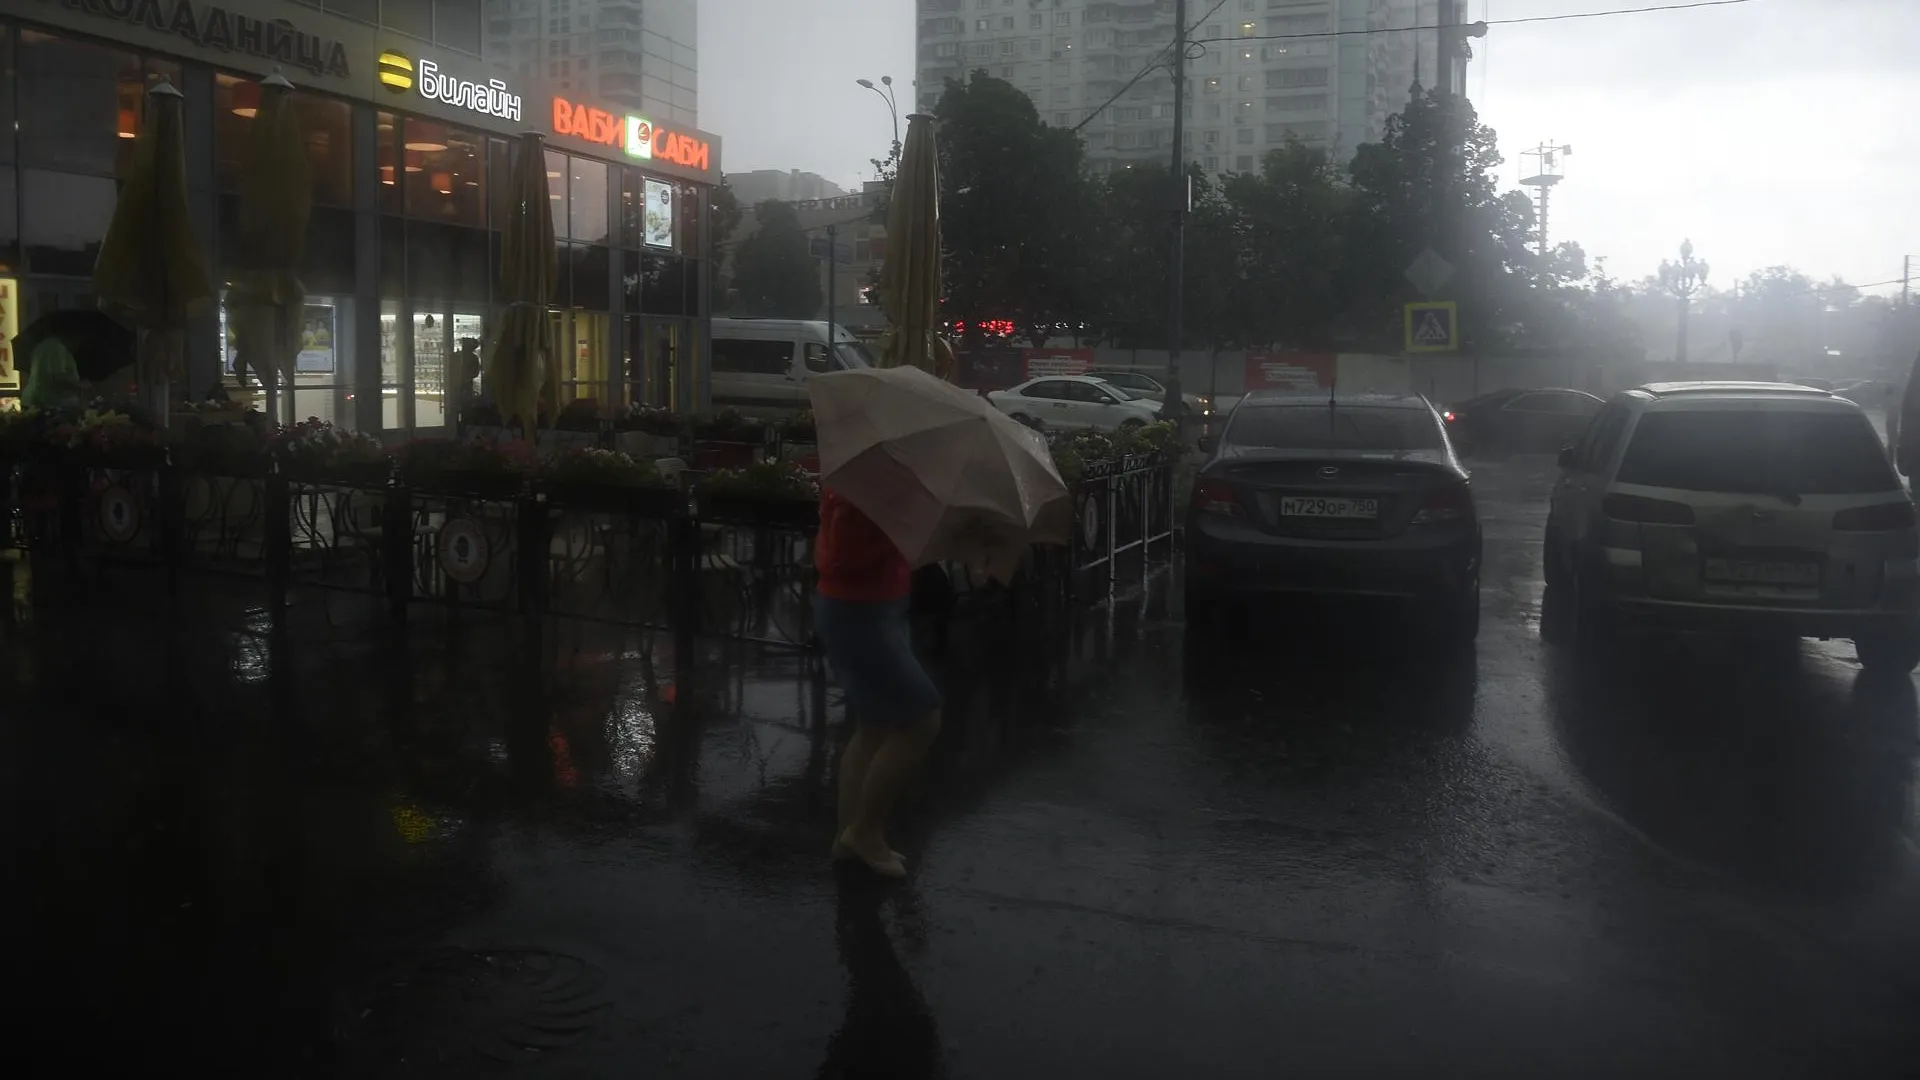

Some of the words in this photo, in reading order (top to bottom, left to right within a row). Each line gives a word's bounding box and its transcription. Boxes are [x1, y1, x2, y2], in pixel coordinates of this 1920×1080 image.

[418, 58, 522, 122] Билайн
[551, 96, 625, 148] ВАБИ
[651, 128, 710, 171] САБИ
[1351, 499, 1375, 513] 750
